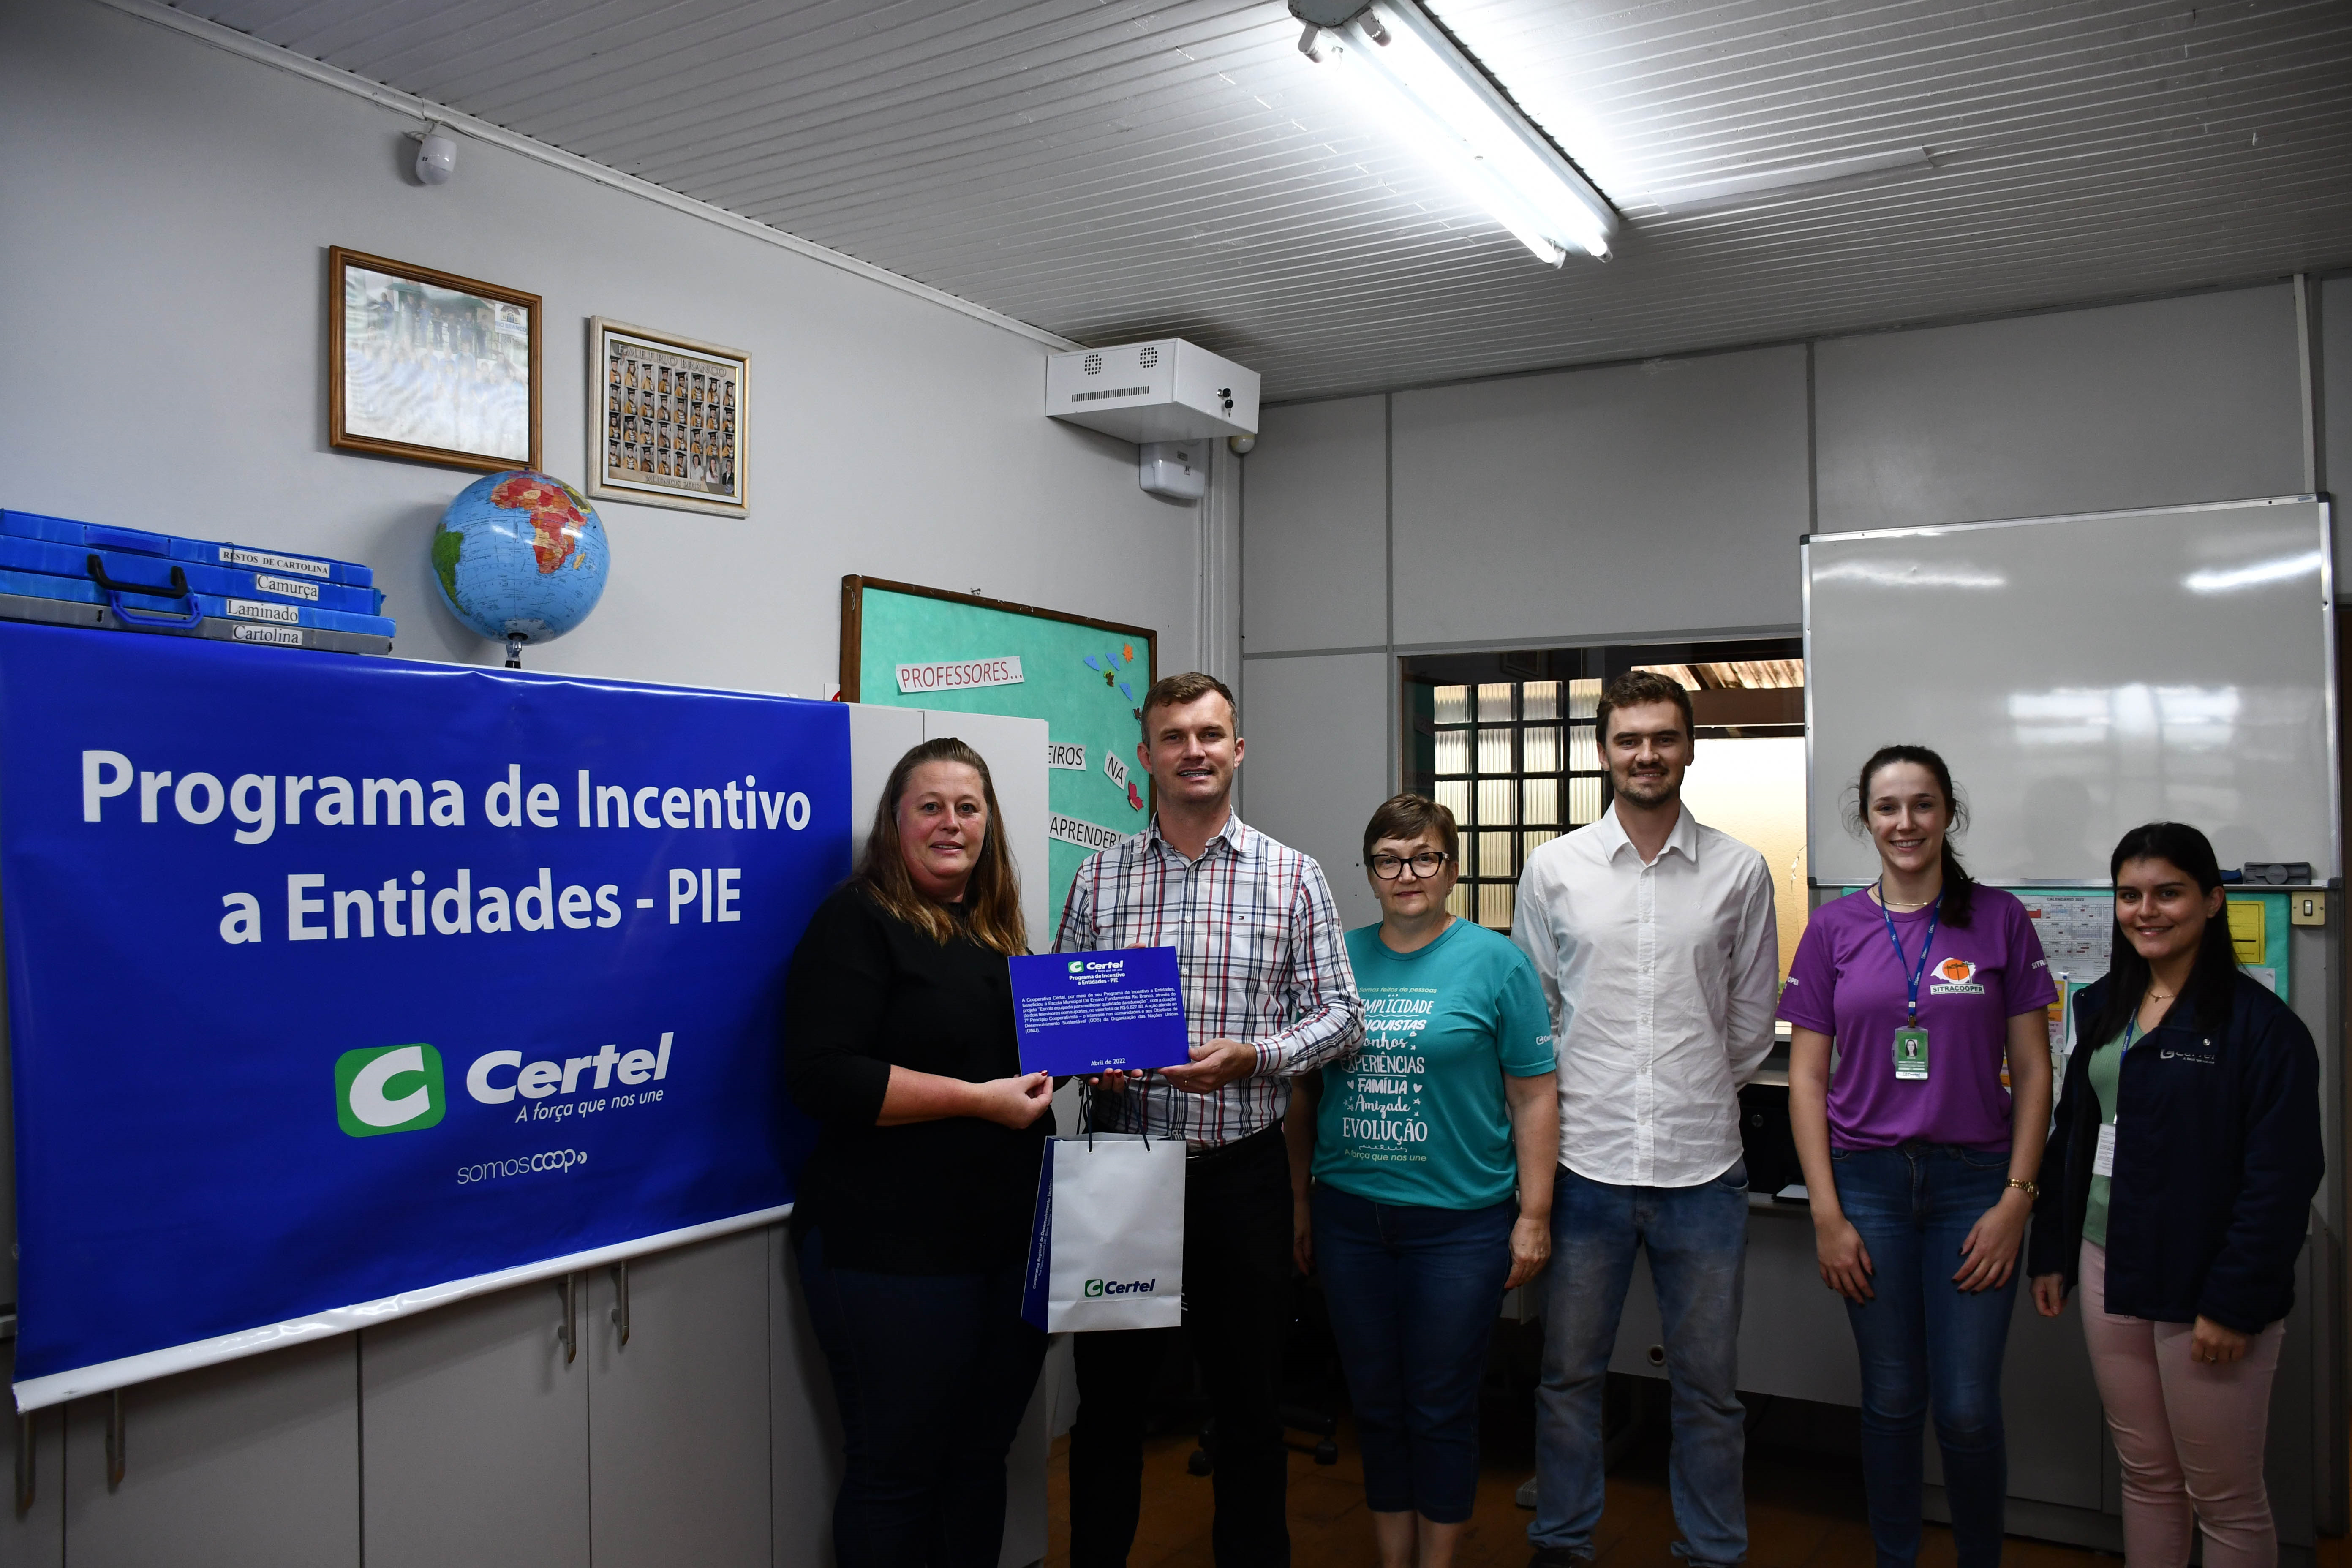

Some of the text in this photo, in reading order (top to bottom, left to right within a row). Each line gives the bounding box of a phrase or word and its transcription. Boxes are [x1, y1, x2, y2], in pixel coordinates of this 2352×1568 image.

[681, 359, 727, 378] BRANCO
[645, 475, 681, 487] ALUNOS
[223, 551, 328, 574] RESTOS DE CARTOLINA
[257, 574, 318, 599] Camurça
[228, 600, 298, 622] Laminado
[234, 625, 299, 643] Cartolina
[901, 661, 1023, 689] PROFESSORES...
[1107, 757, 1124, 785] NA
[82, 749, 812, 844] Programa de Incentivo
[219, 890, 263, 945] a
[287, 868, 622, 942] Entidades
[668, 868, 742, 925] PIE
[1086, 960, 1124, 970] Certel
[466, 1031, 674, 1105] Certel
[1358, 1077, 1407, 1095] FAMÍLIA
[514, 1089, 664, 1124] A força que nos une
[1355, 1094, 1411, 1119] Amizade
[1342, 1117, 1428, 1145] EVOLUÇÃO
[1105, 1279, 1155, 1295] Certel
